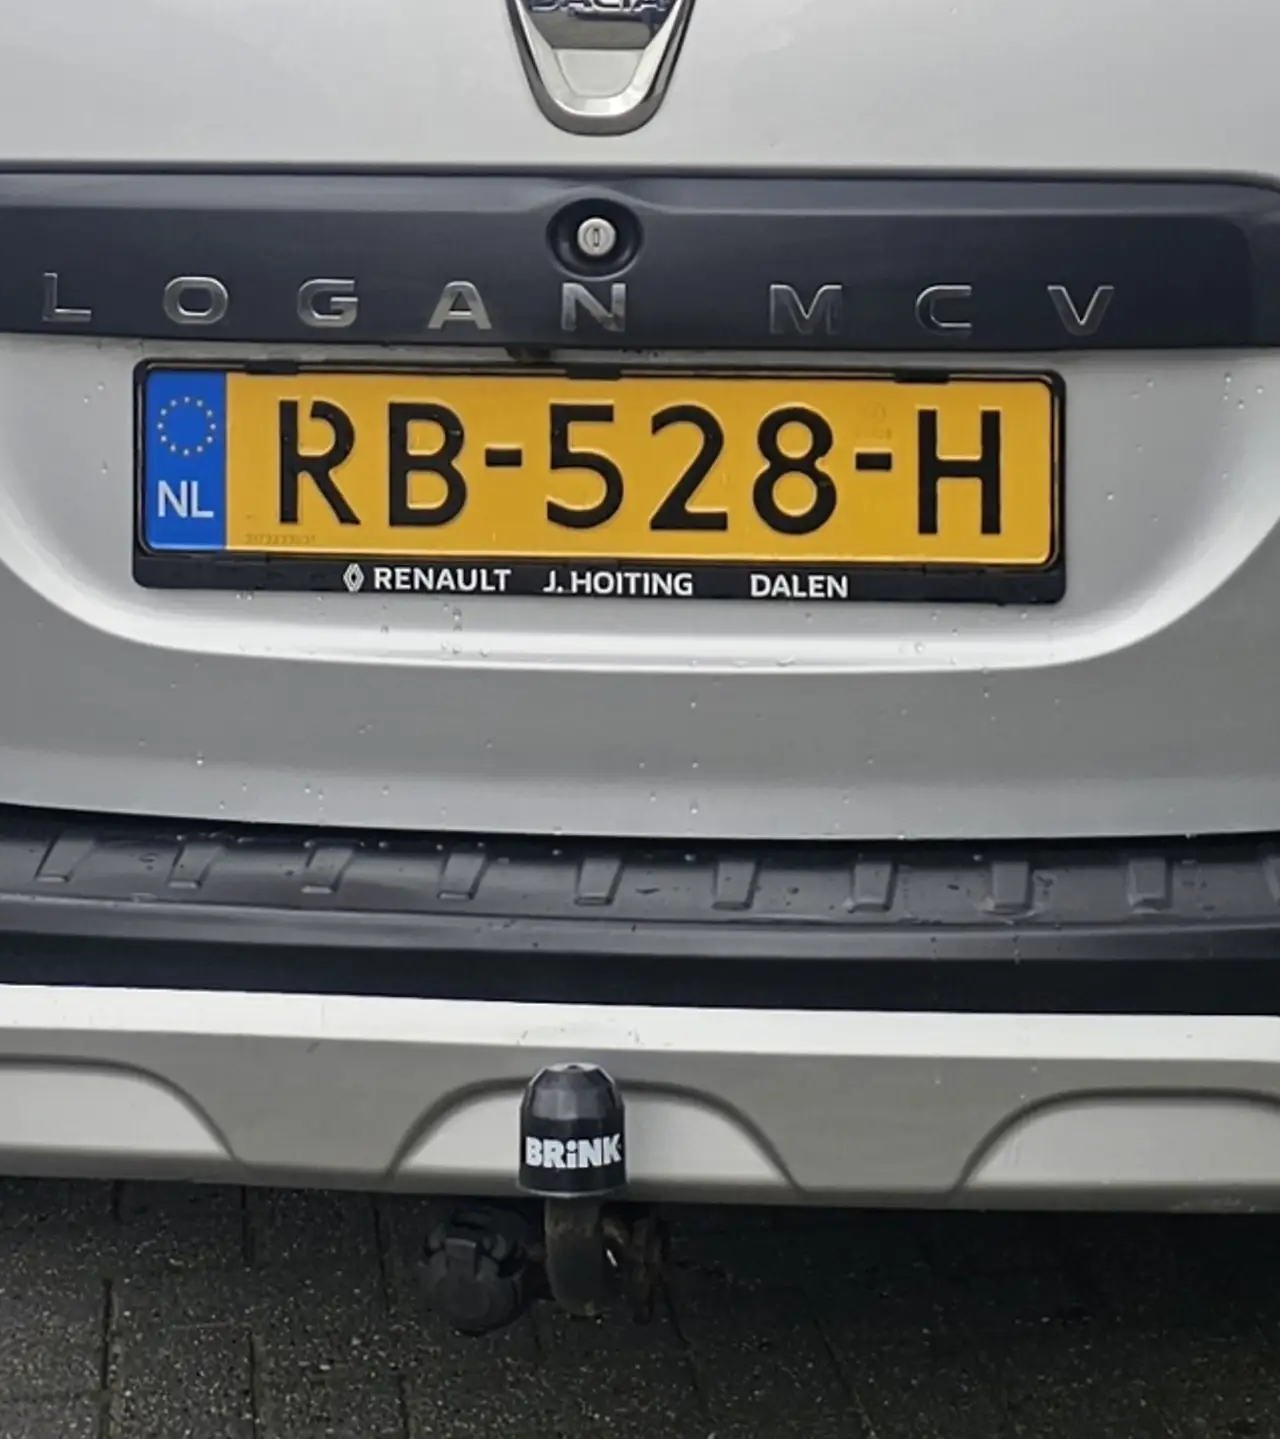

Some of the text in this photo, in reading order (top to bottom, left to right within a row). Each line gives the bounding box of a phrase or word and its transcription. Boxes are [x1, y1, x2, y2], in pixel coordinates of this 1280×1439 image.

[41, 271, 627, 335] LOGAN
[768, 282, 1117, 336] MCV
[277, 399, 1002, 537] RB-528-H
[158, 480, 214, 518] NL
[373, 566, 511, 592] RENAULT
[750, 573, 849, 599] DALEN
